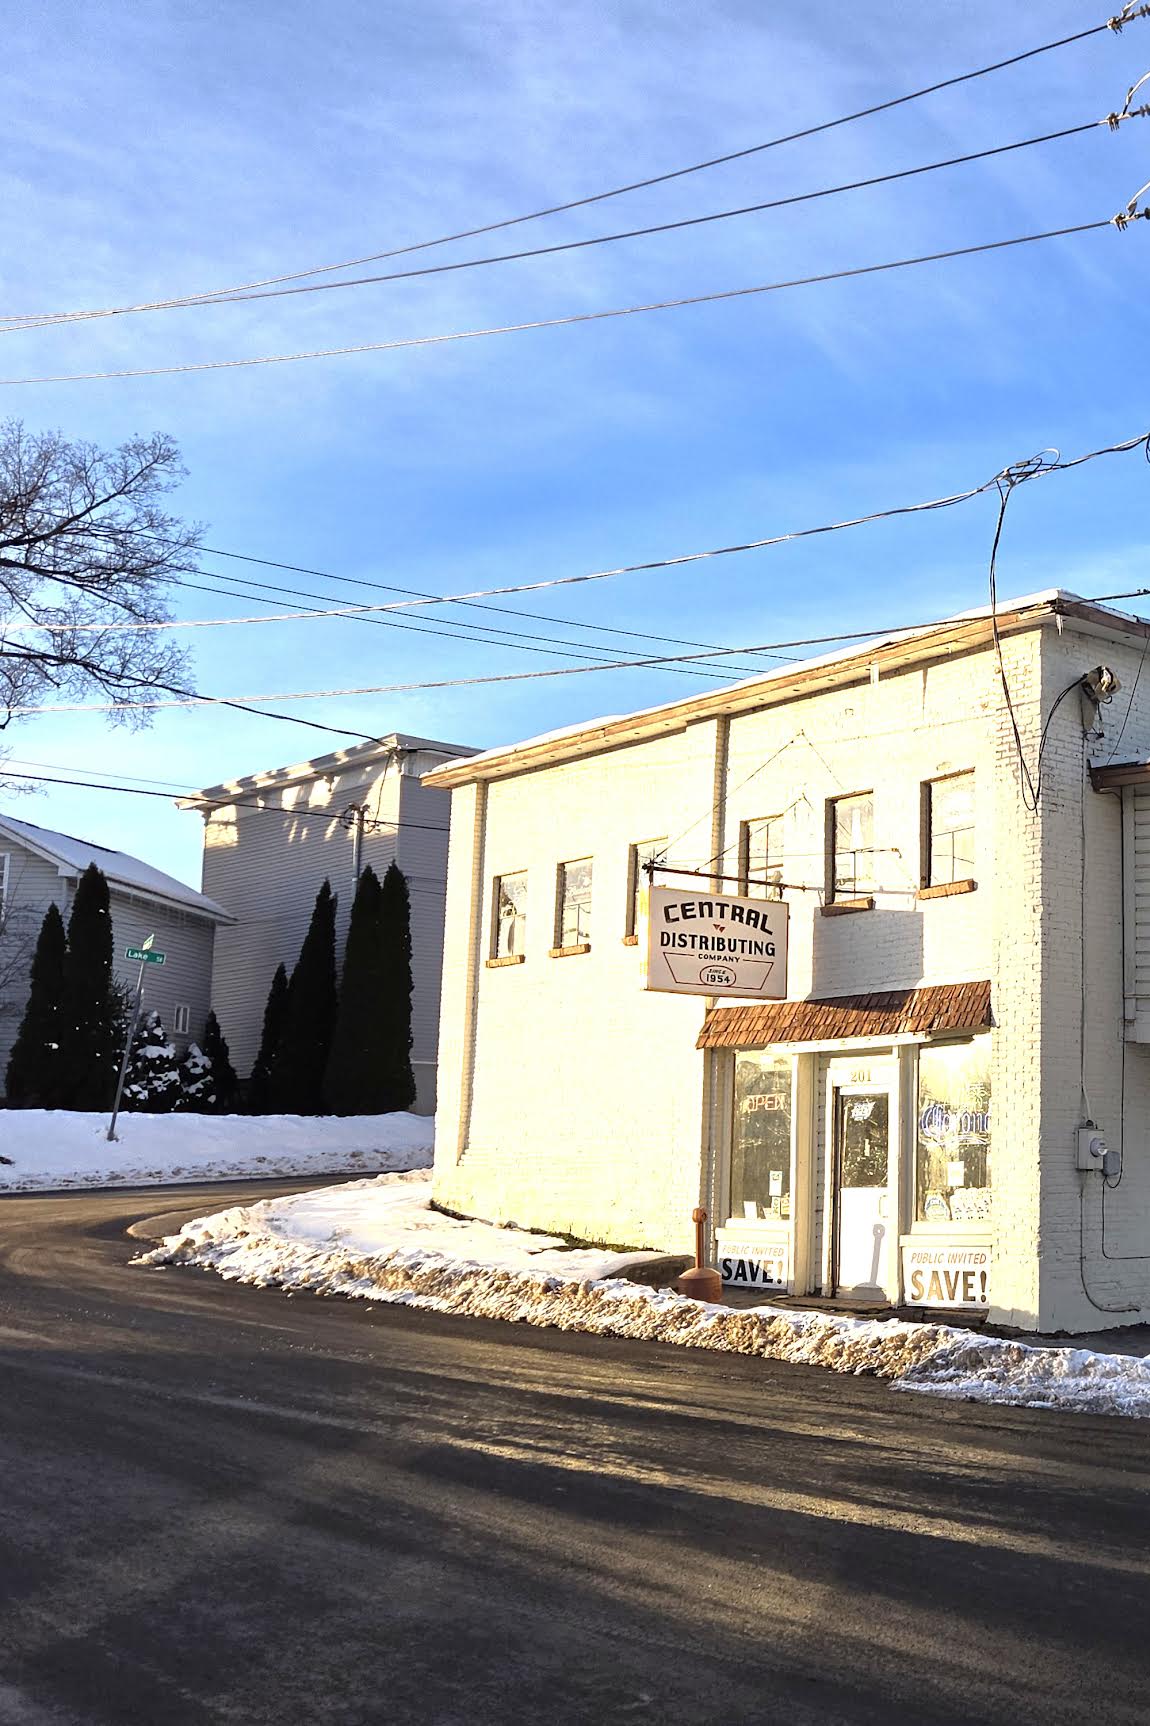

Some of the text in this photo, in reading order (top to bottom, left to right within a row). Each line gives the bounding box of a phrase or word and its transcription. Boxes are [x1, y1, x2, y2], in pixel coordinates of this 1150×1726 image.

[663, 901, 773, 936] CENTRAL
[660, 931, 776, 957] DISTRIBUTING
[128, 950, 149, 960] Lake
[698, 953, 741, 963] COMPANY
[706, 973, 731, 984] 1954
[850, 1071, 872, 1082] 201
[748, 1094, 787, 1111] OPEN
[722, 1245, 785, 1257] PUBLIC INVITED
[910, 1253, 987, 1265] PUBLIC INVITED
[722, 1257, 784, 1285] SAVE!
[910, 1269, 988, 1303] SAVE!
